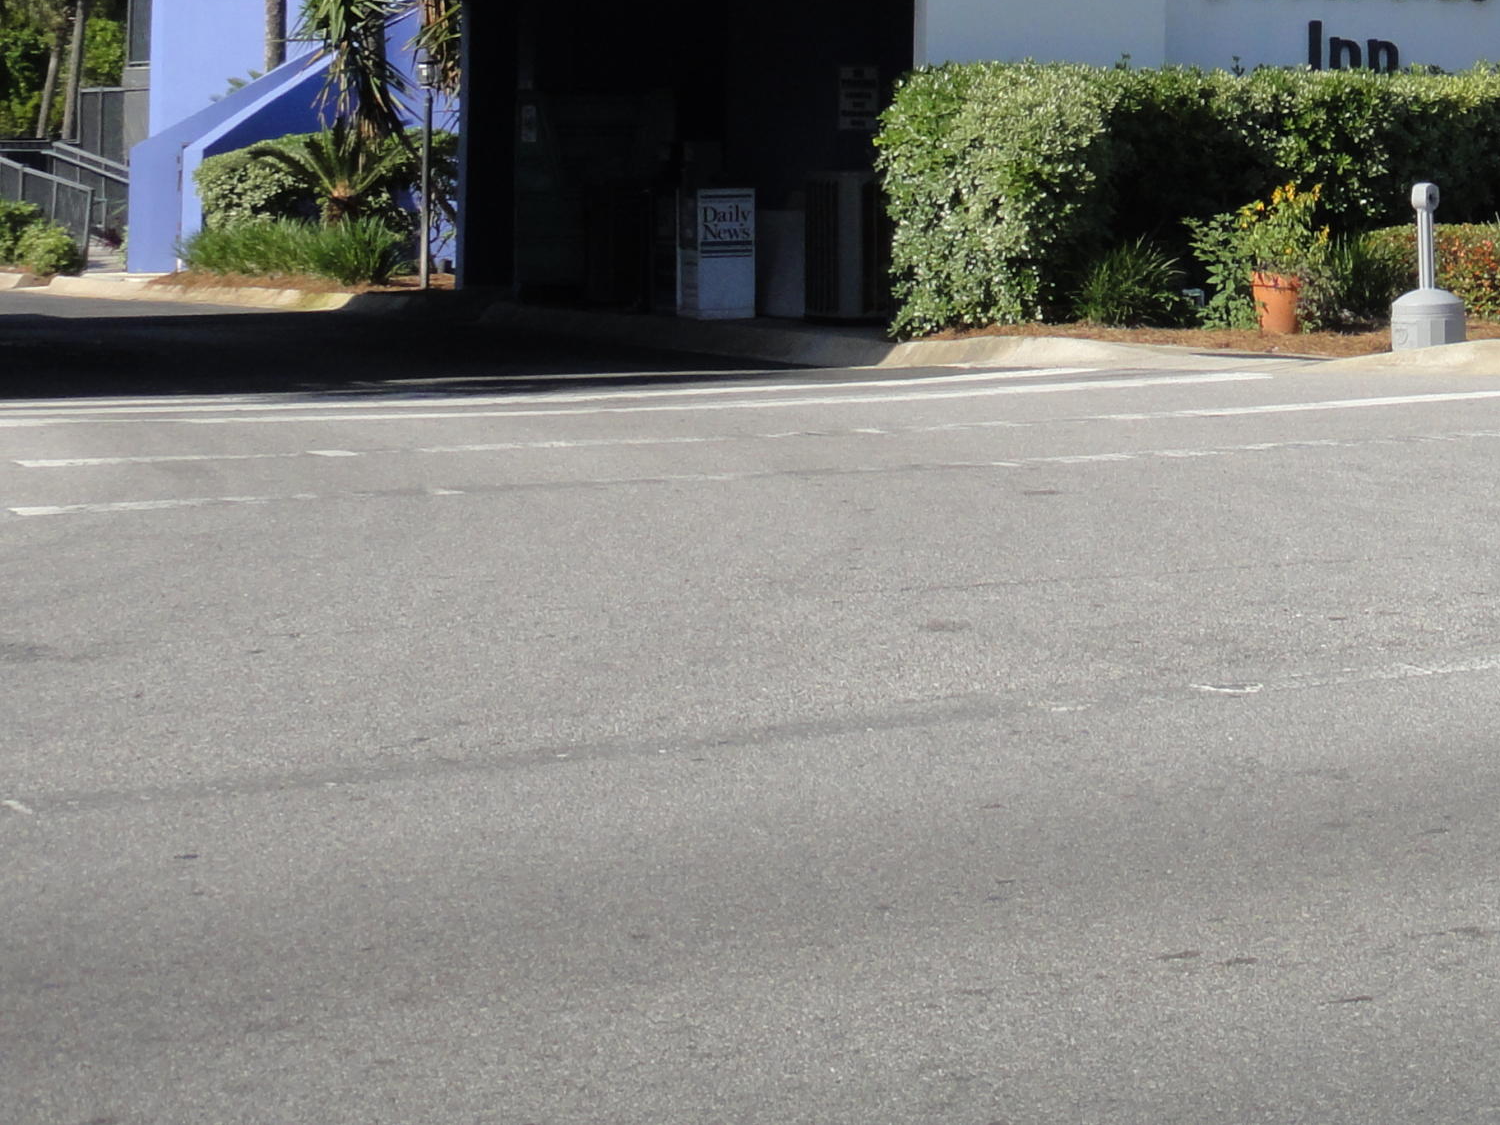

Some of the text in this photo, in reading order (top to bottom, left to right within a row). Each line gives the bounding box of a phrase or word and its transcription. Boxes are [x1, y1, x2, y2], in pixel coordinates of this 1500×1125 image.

[1308, 19, 1400, 73] Inn
[702, 204, 751, 226] Daily
[702, 224, 750, 242] News
